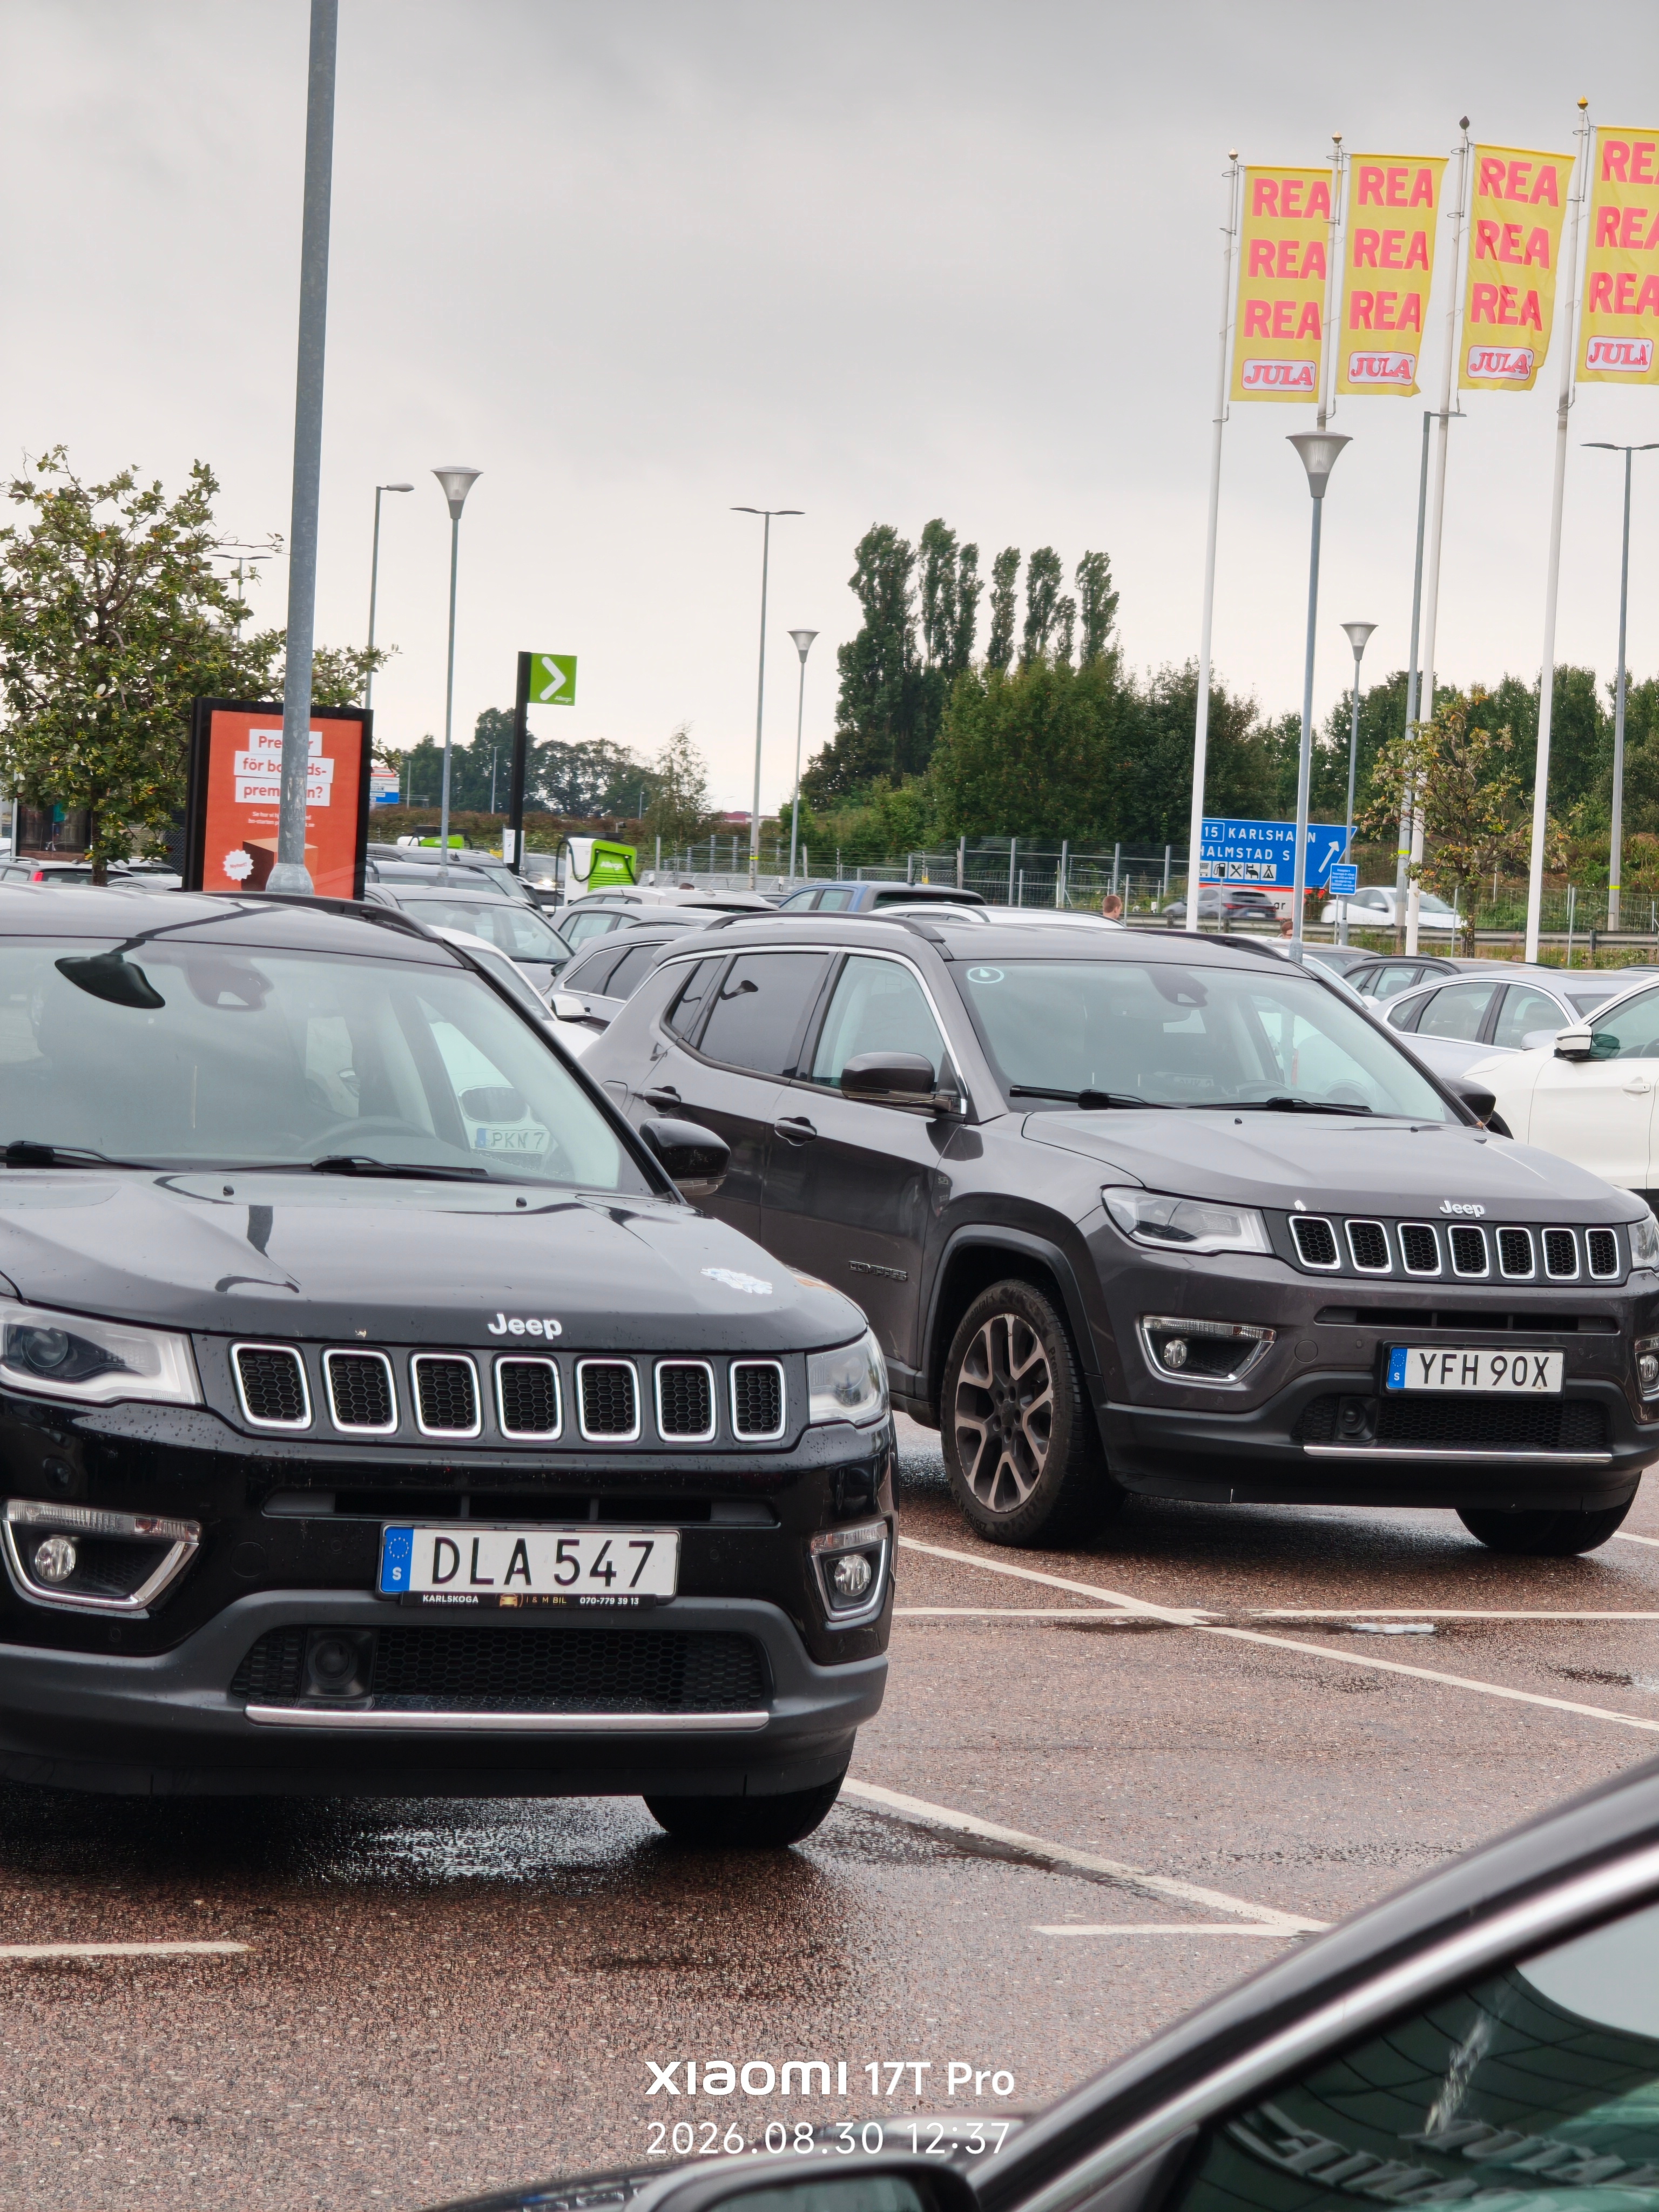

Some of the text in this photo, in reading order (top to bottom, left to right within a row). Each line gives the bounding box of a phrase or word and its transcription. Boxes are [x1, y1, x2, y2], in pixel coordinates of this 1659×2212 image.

[1601, 140, 1659, 185] RE
[1252, 178, 1331, 220] REA
[1358, 166, 1434, 208] REA
[1479, 157, 1559, 207] REA
[1249, 239, 1327, 280] REA
[1353, 228, 1429, 271] REA
[1475, 219, 1550, 269] REA
[1471, 282, 1543, 332] REA
[1589, 272, 1659, 317] REA
[1244, 299, 1322, 340] REA
[1350, 291, 1421, 333] REA
[1350, 358, 1411, 379] JULA
[1470, 353, 1530, 373] JULA
[1588, 342, 1648, 366] JULA
[1244, 365, 1313, 386] JULA
[258, 736, 314, 750] Prer
[242, 757, 327, 776] för bods-
[244, 786, 323, 799] premn?
[1205, 826, 1316, 843] 15 KARLSHAN
[1283, 850, 1290, 861] S
[1439, 1199, 1485, 1218] Jeep
[487, 1313, 562, 1340] Jeep
[1394, 1353, 1549, 1387] S YFH 90X
[392, 1536, 655, 1588] S DLA 547
[423, 1595, 479, 1603] KARLSKOGA
[580, 1597, 615, 1605] 070-779
[617, 1597, 628, 1606] 39
[630, 1597, 639, 1606] 13
